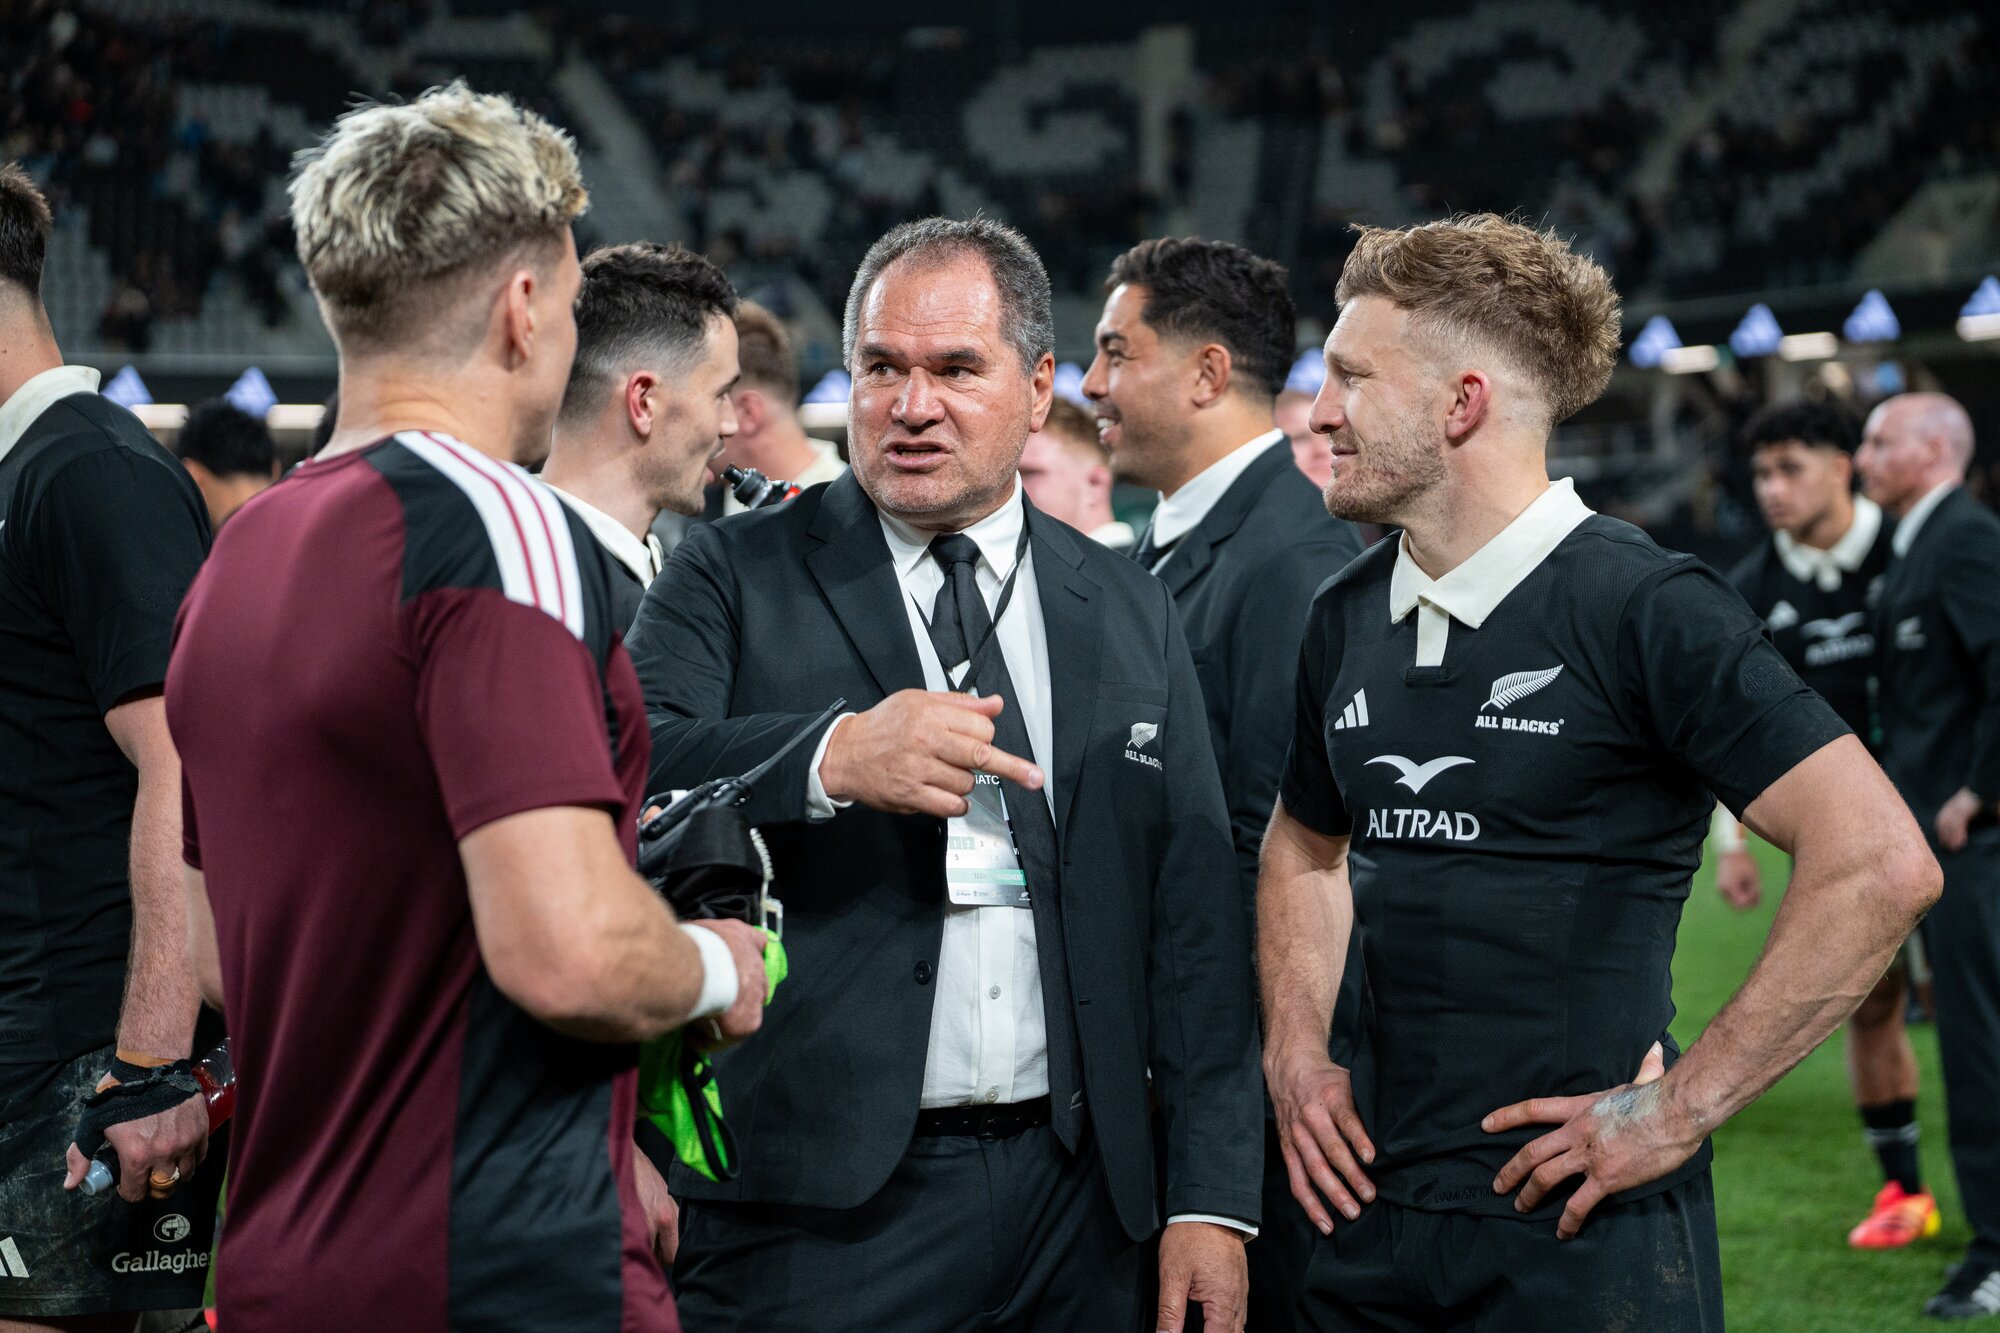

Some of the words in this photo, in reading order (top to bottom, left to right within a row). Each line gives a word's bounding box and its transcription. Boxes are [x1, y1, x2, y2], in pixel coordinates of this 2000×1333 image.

[1475, 715, 1499, 729] ALL
[1501, 717, 1560, 736] BLACKS
[1125, 749, 1139, 762] ALL
[975, 774, 1000, 785] ATC
[1366, 808, 1481, 841] ALTRAD
